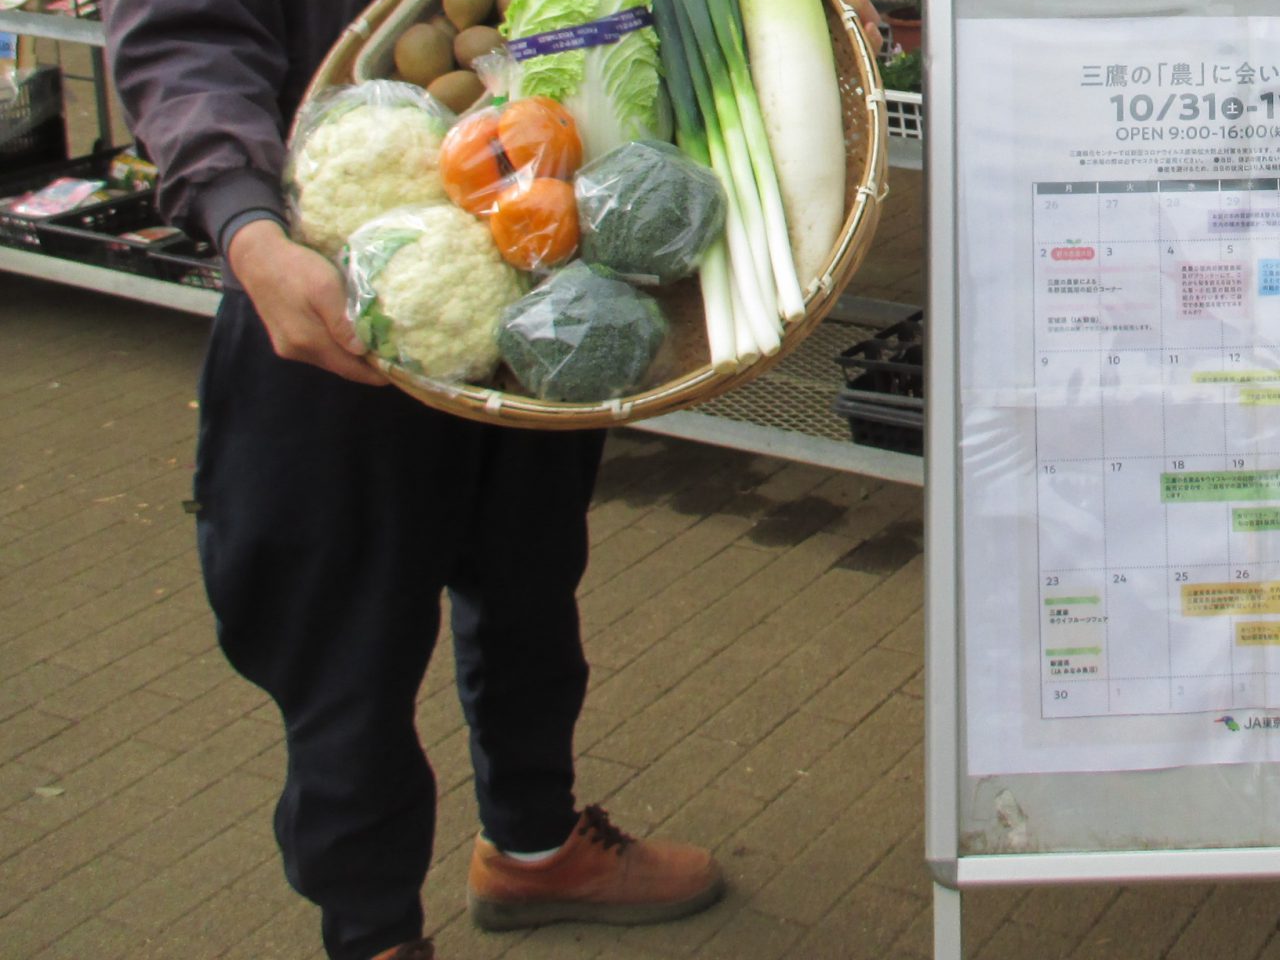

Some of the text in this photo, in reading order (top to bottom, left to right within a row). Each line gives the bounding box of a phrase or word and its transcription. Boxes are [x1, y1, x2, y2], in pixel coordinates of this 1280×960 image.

[1116, 127, 1163, 141] OPEN
[1040, 248, 1047, 257] 2
[1106, 247, 1113, 257] 3
[1167, 246, 1175, 255] 4
[1227, 244, 1234, 254] 5
[1041, 357, 1049, 367] 9
[1107, 355, 1121, 365] 10
[1169, 354, 1179, 364] 11
[1229, 353, 1241, 362] 12
[1044, 465, 1057, 474] 16
[1111, 462, 1123, 472] 17
[1172, 460, 1185, 470] 18
[1233, 459, 1245, 469] 19
[1046, 576, 1059, 586] 23
[1113, 574, 1127, 583] 24
[1175, 572, 1188, 581] 25
[1235, 570, 1249, 579] 26
[1054, 690, 1068, 700] 30
